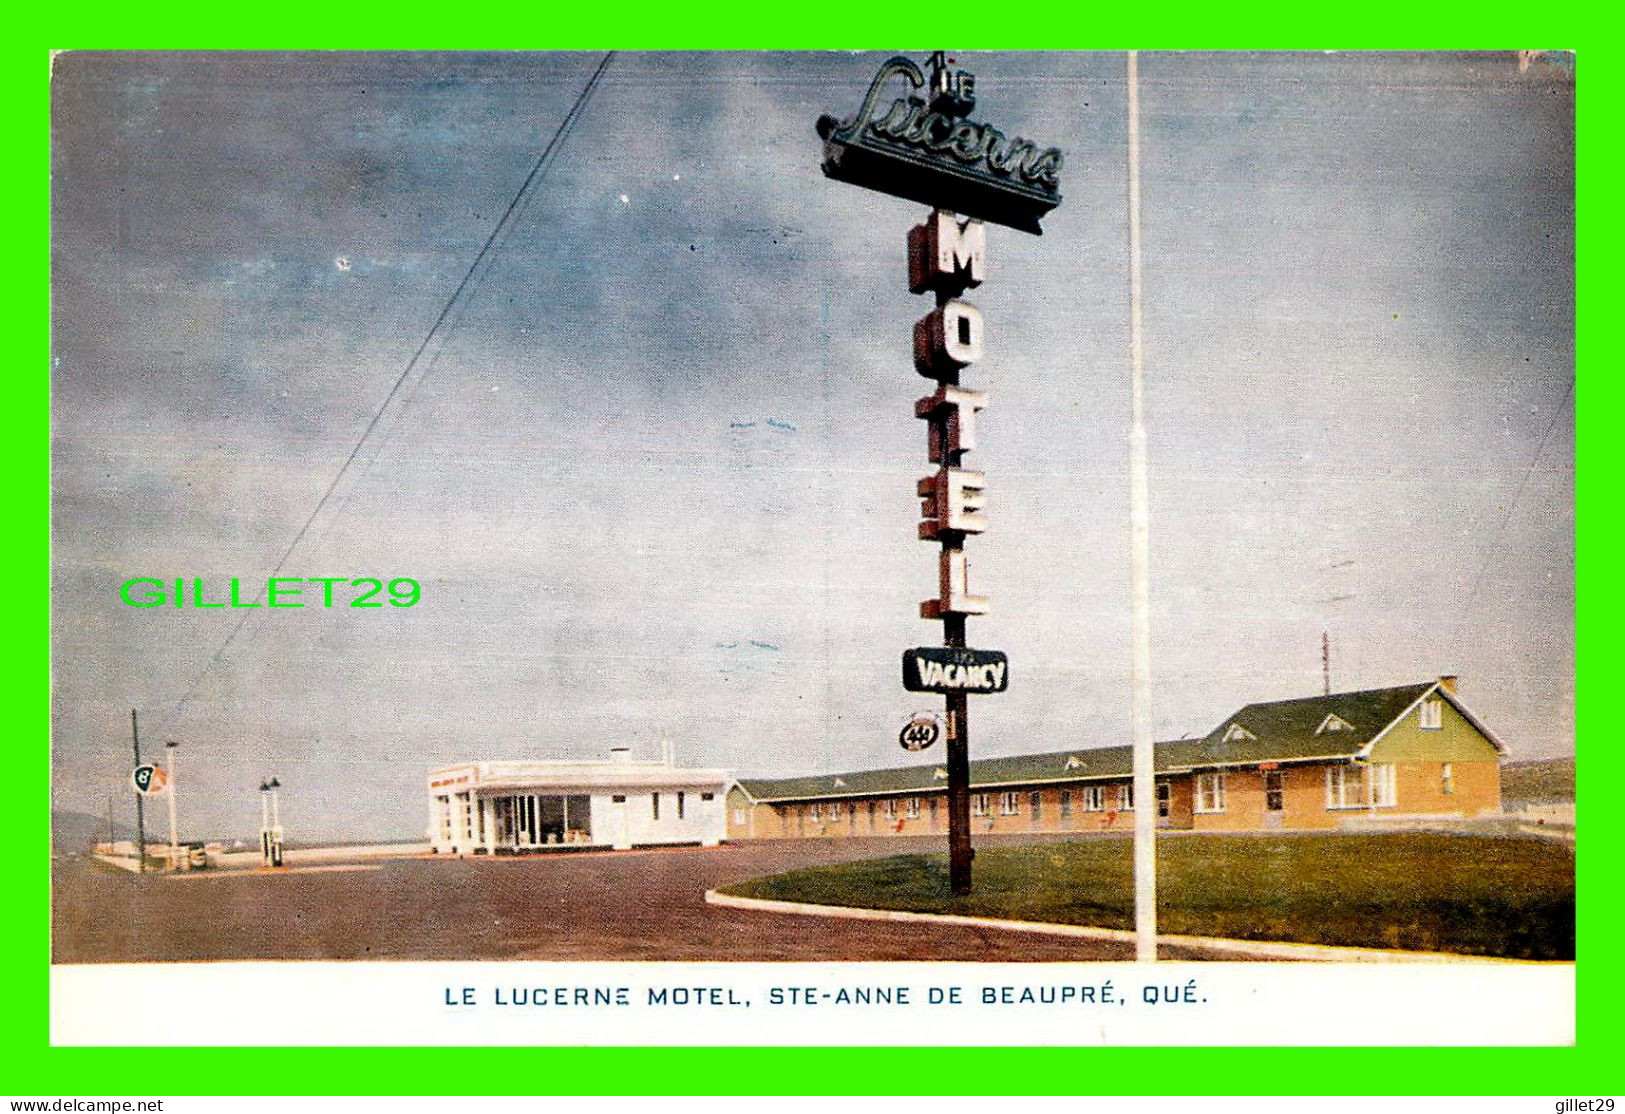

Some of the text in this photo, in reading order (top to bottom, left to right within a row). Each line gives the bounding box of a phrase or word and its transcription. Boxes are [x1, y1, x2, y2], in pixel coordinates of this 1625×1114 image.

[834, 56, 1065, 186] Lucerne
[934, 208, 991, 615] MOTEL
[916, 657, 1005, 689] VACANCY
